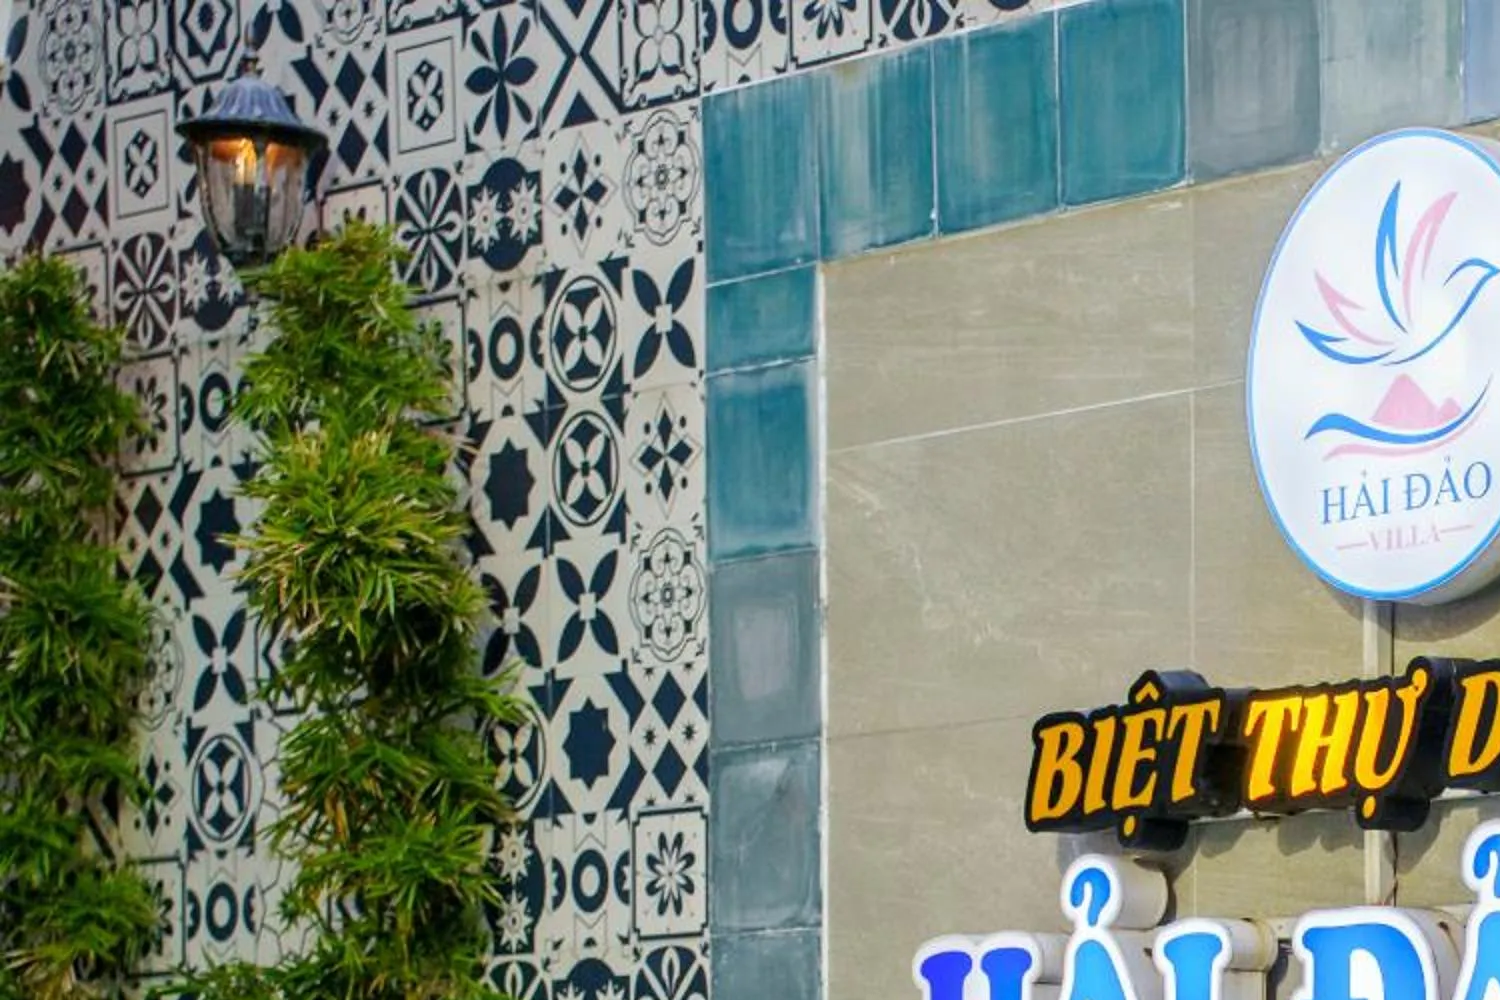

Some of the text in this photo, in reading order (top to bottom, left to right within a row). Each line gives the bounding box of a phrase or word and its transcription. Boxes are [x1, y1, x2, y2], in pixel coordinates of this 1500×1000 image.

[1368, 524, 1441, 551] VILLA
[1030, 681, 1222, 838] BIỆT
[1244, 668, 1428, 819] THỰ
